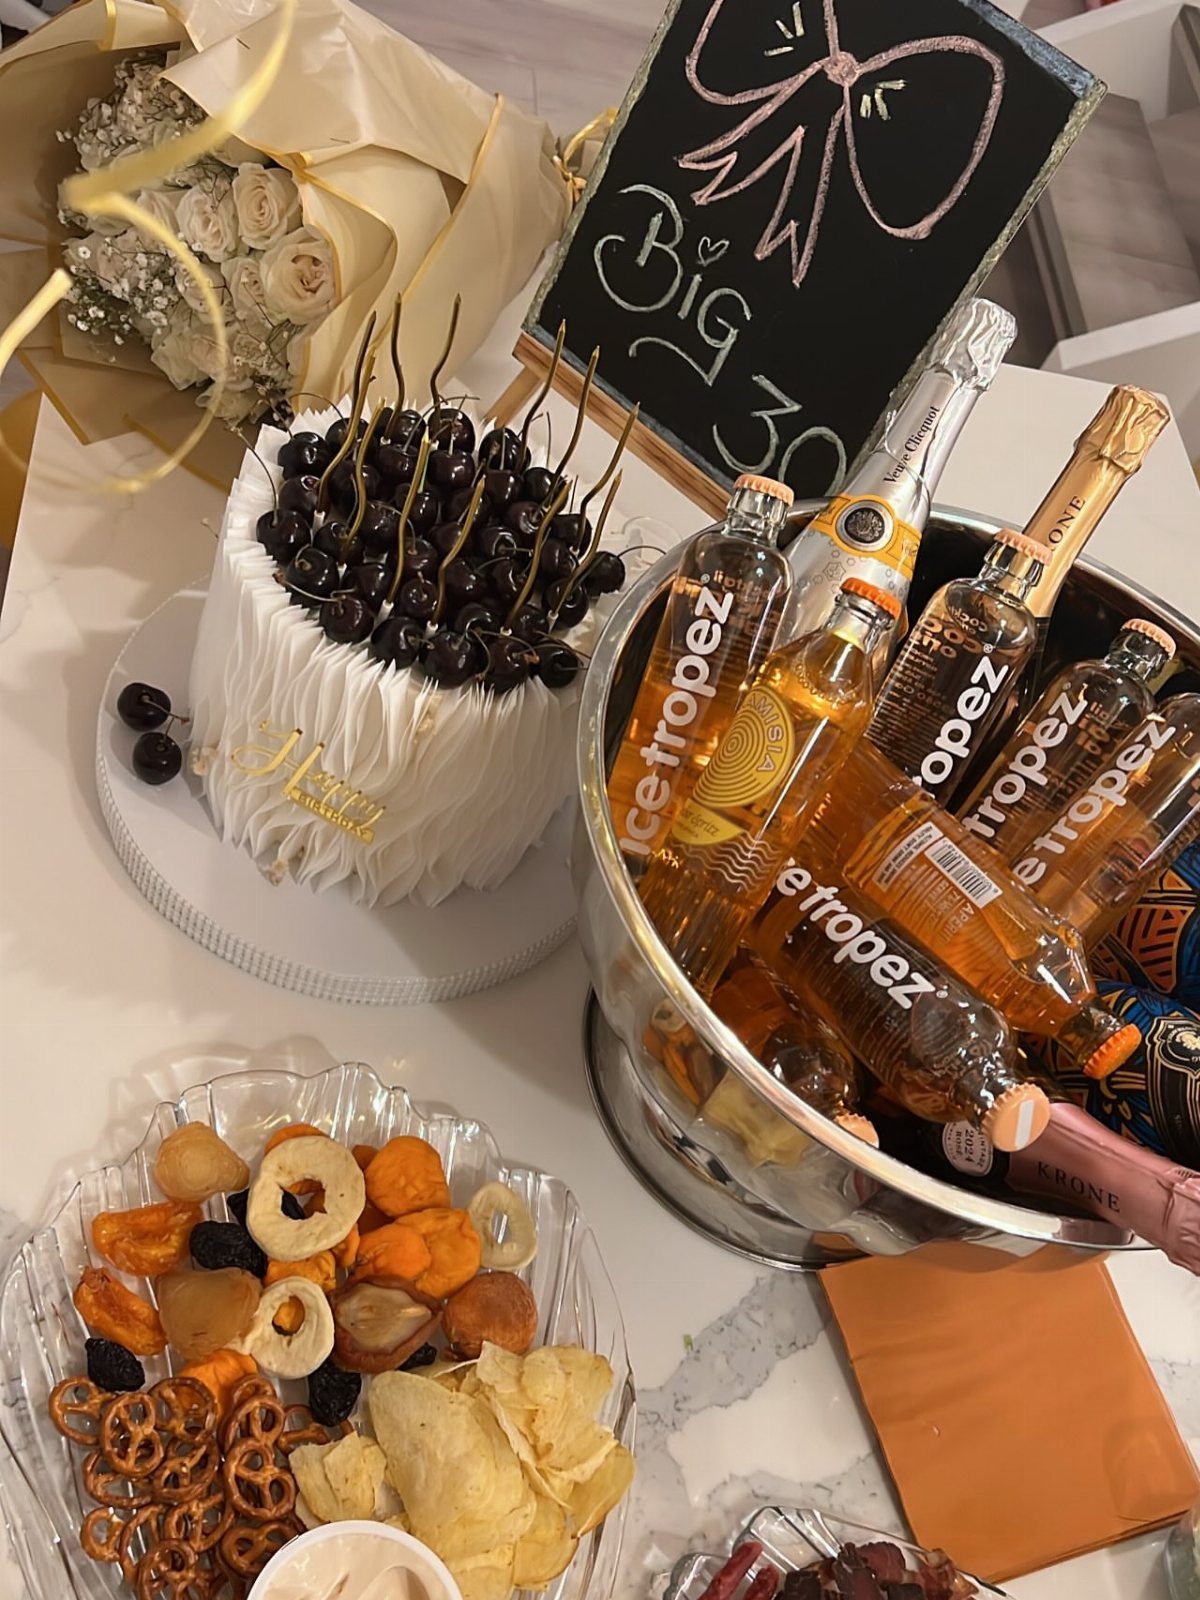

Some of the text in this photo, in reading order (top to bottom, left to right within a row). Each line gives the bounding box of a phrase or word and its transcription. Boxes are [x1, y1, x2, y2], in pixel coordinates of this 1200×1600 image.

[713, 375, 847, 498] 30
[883, 405, 941, 484] Veuve Clicquot
[1047, 495, 1086, 546] ONE
[640, 586, 734, 768] tropez
[917, 655, 1009, 787] opez
[231, 720, 387, 829] Happy
[961, 692, 1088, 838] tropez
[1034, 722, 1176, 855] tropez
[799, 886, 936, 1009] tropez
[964, 1129, 976, 1164] 2024
[1037, 1161, 1121, 1214] KRONE
